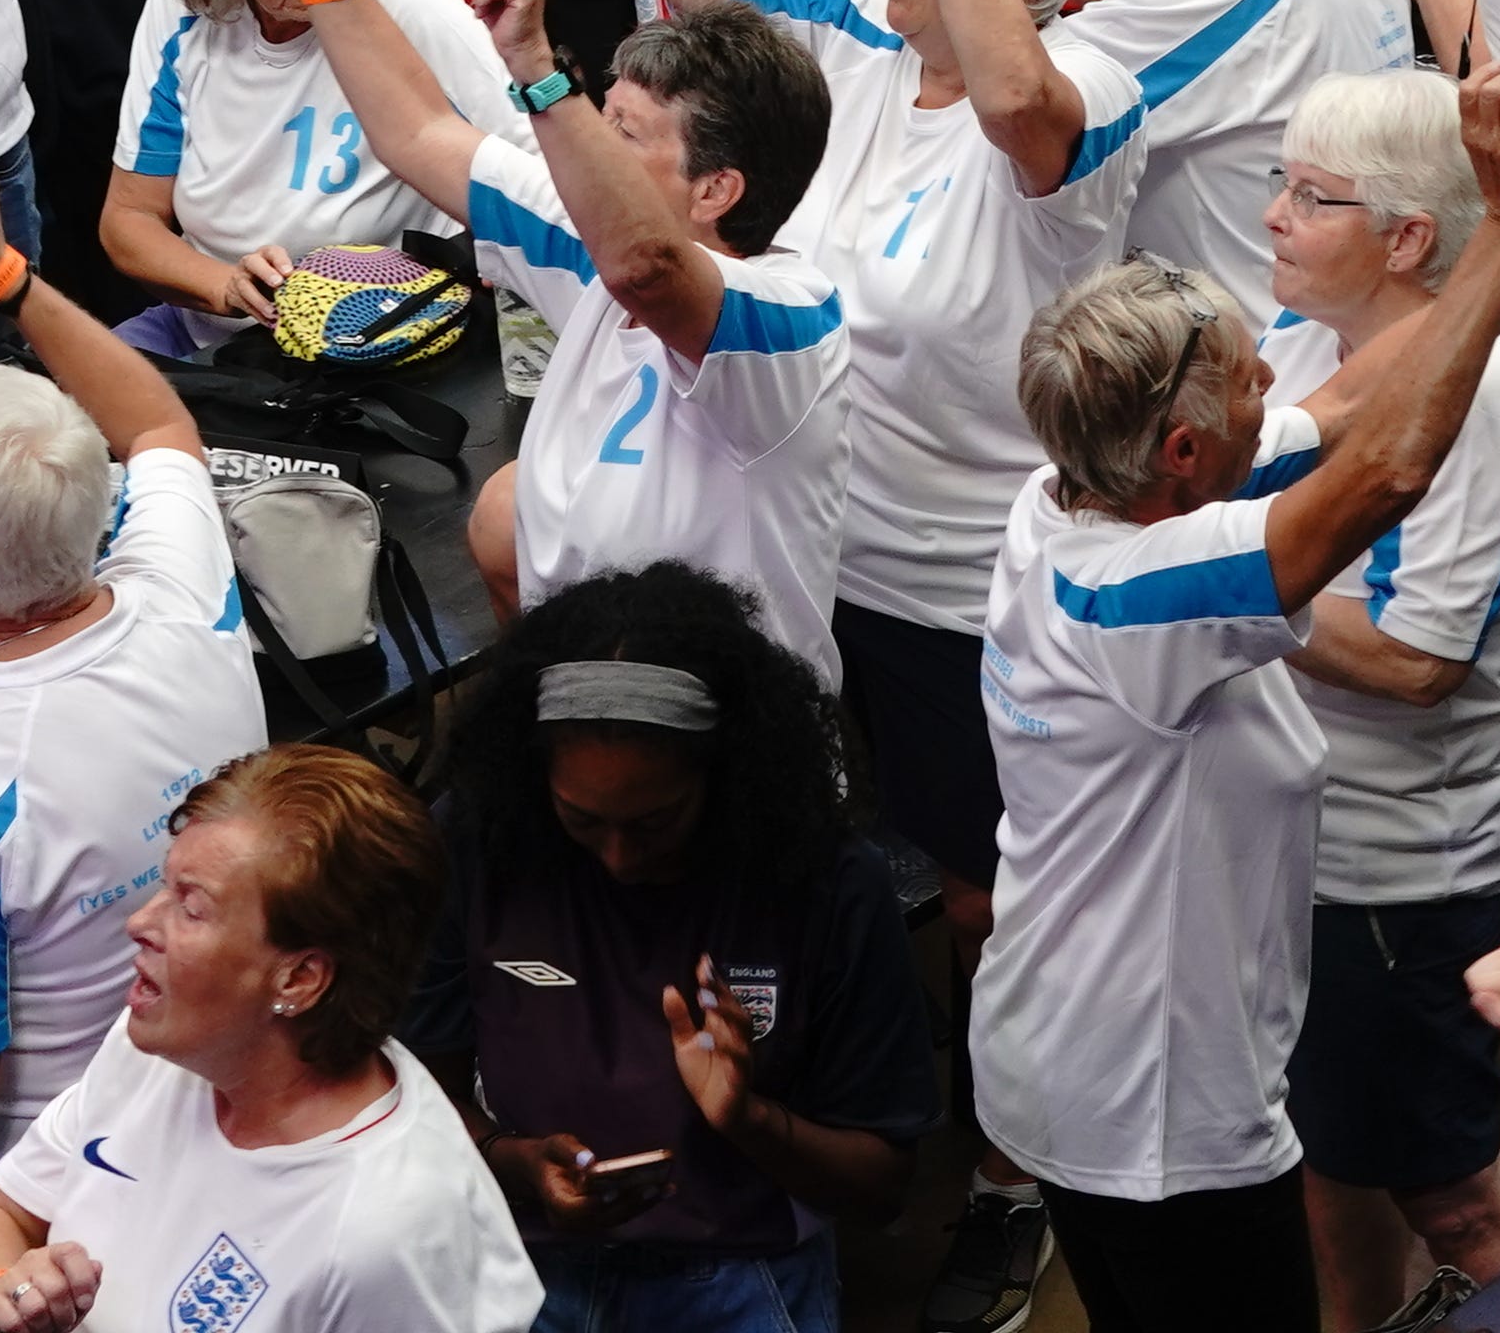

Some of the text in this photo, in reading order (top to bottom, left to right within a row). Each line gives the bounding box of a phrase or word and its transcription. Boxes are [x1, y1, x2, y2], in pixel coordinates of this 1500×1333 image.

[283, 107, 363, 195] 13
[599, 364, 659, 465] 2
[204, 447, 341, 480] ESERVED
[161, 768, 203, 804] 1972
[80, 865, 161, 915] (YES WE
[729, 968, 777, 979] ENGLAND
